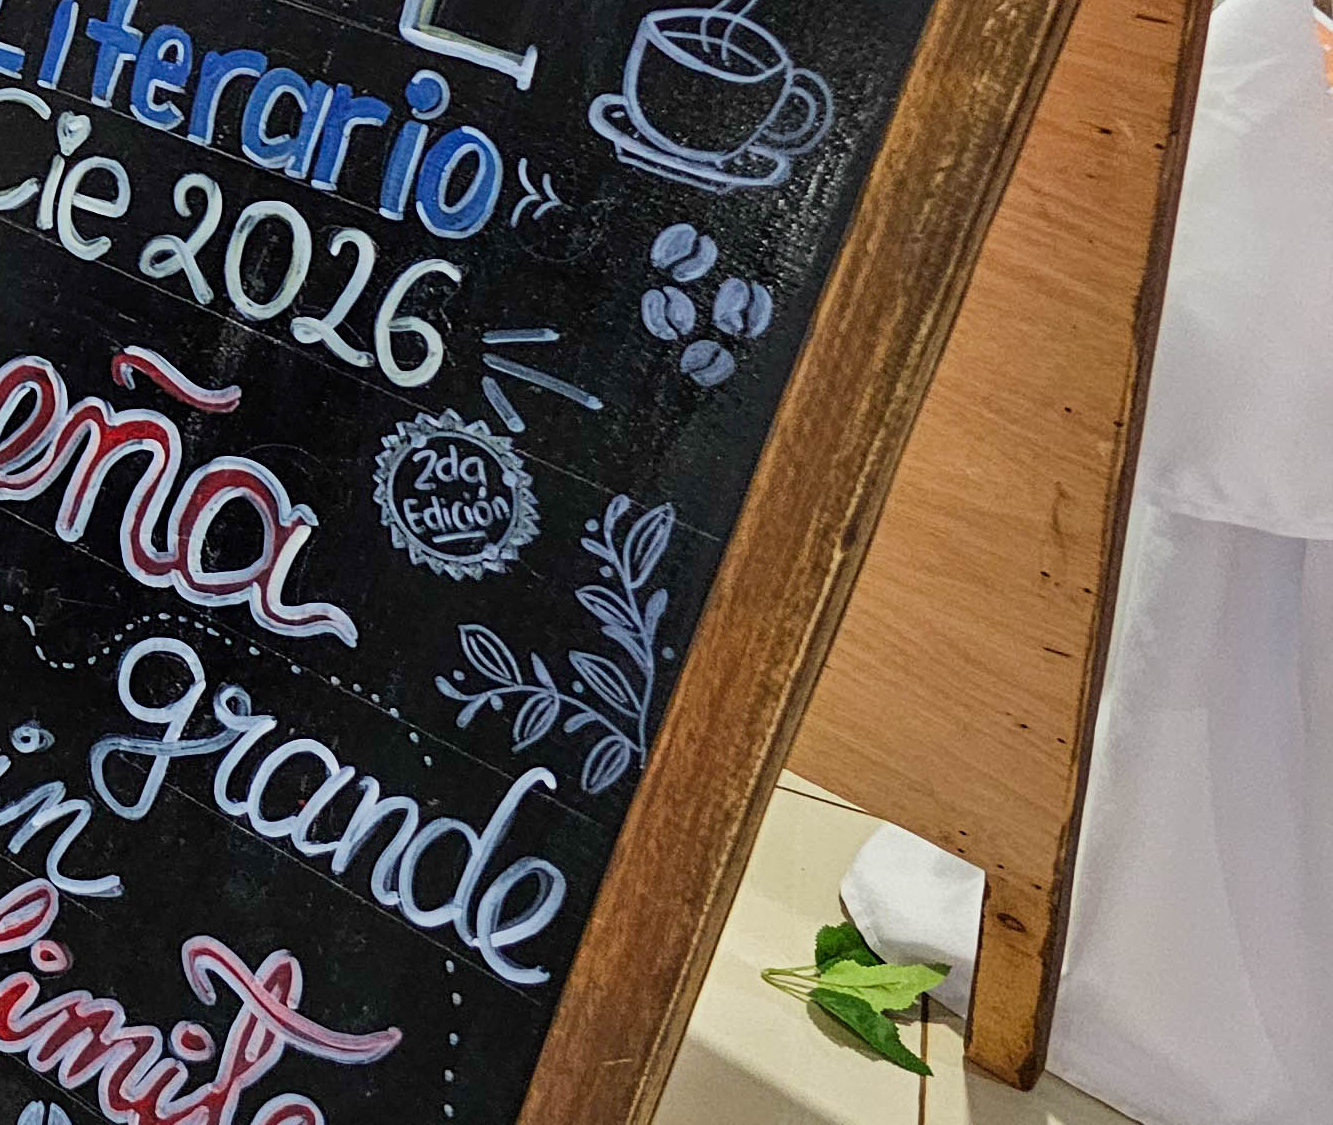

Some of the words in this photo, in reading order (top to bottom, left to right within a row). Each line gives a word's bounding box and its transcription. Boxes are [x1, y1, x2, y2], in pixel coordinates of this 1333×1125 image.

[139, 173, 463, 387] 2026
[403, 486, 510, 534] Edición
[412, 444, 487, 491] 2da
[89, 637, 566, 985] grande
